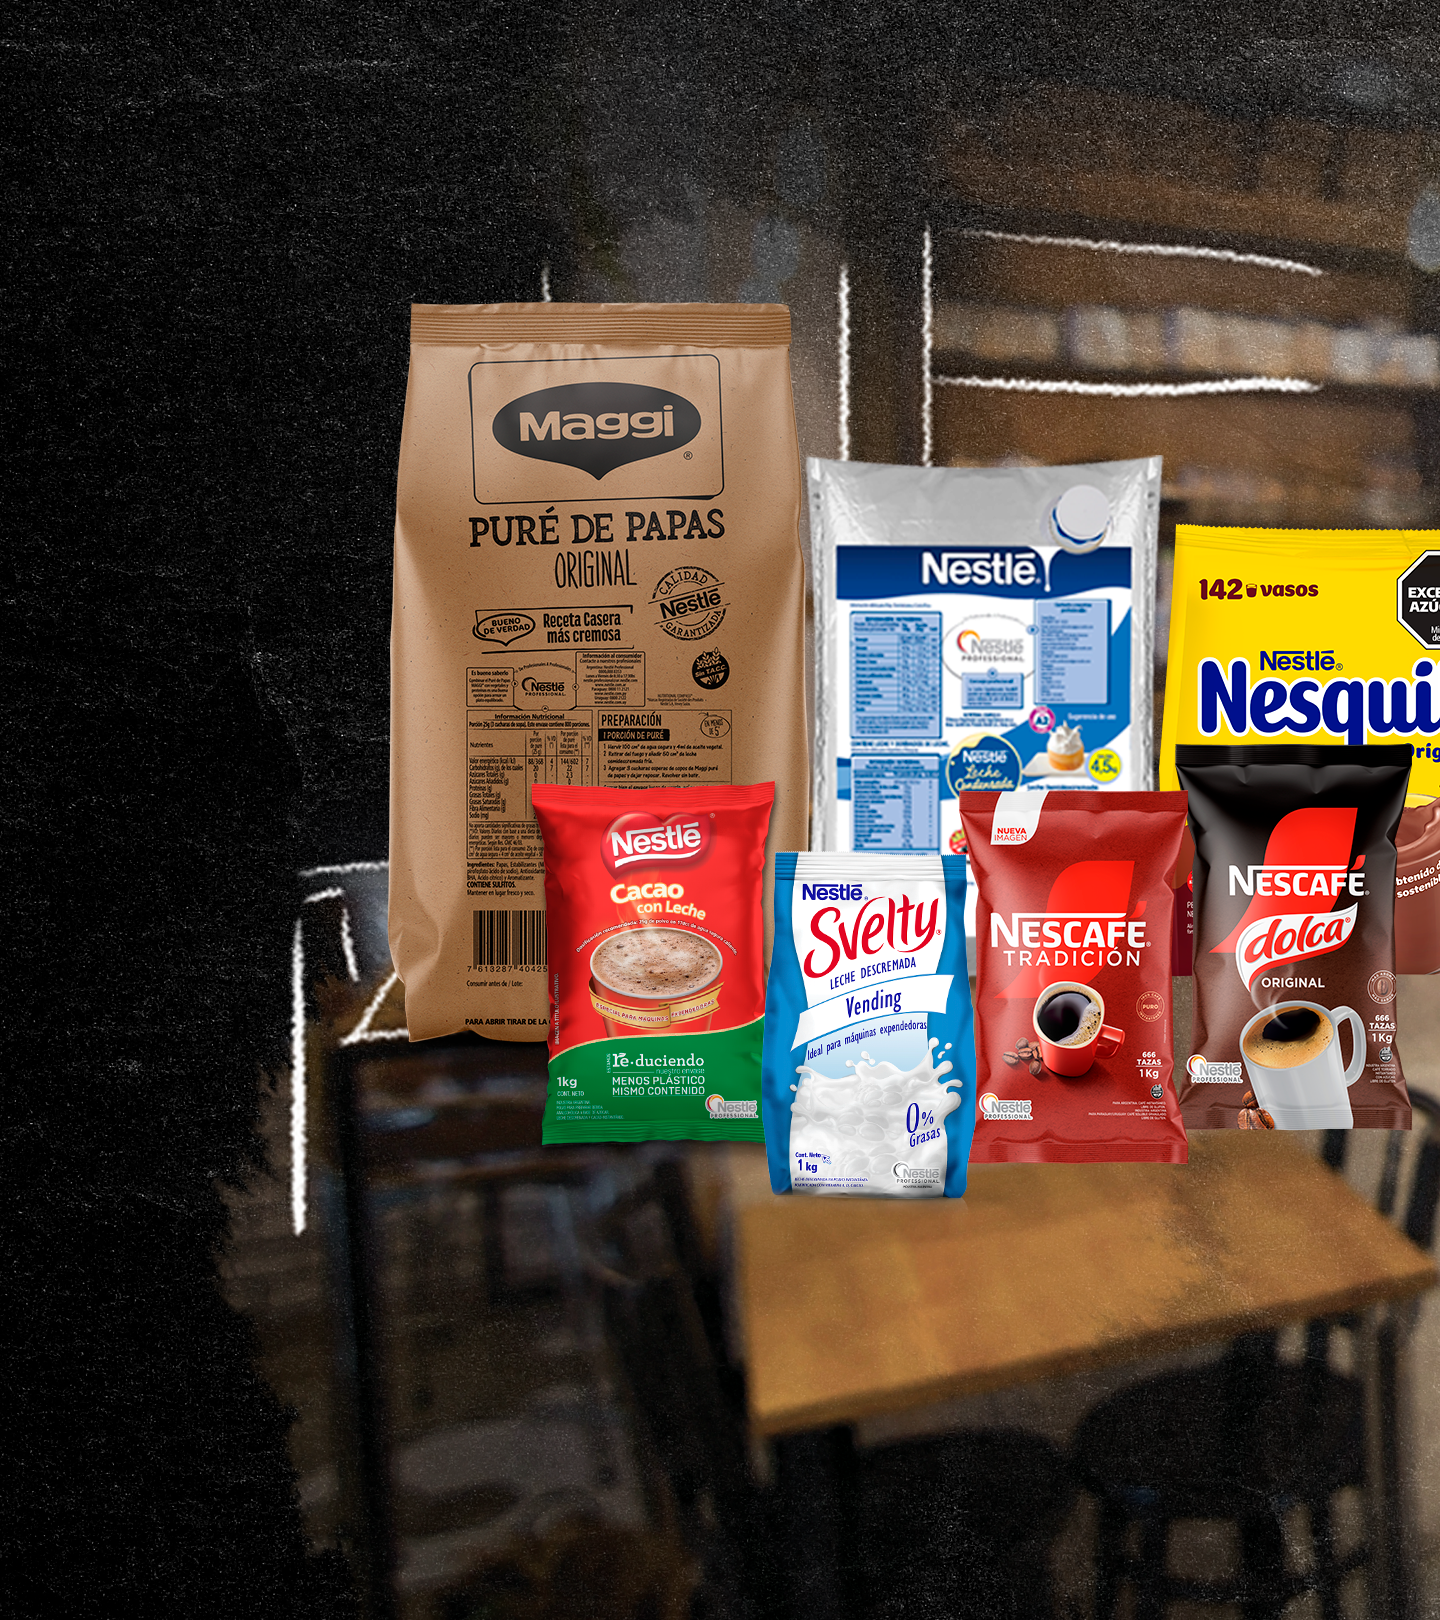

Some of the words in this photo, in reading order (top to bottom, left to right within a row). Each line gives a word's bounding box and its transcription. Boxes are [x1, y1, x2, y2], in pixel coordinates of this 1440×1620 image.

[519, 404, 674, 442] Maggi
[469, 506, 560, 548] PURÉ
[571, 513, 614, 544] DE
[625, 508, 726, 542] PAPAS
[554, 549, 637, 589] ORIGINAL
[922, 552, 1036, 585] Nestlé
[659, 571, 708, 595] CALIDAD
[1199, 578, 1244, 600] 142
[1260, 582, 1319, 598] vasos
[660, 588, 721, 619] Nestlé
[483, 627, 495, 635] DE
[496, 623, 530, 634] VERDAD
[491, 617, 521, 627] BUENO
[543, 612, 581, 628] Receta
[583, 612, 621, 627] Casera
[665, 610, 721, 637] GARANTIZADA
[547, 628, 570, 643] más
[572, 628, 621, 643] cremosa
[971, 638, 1024, 654] Nestlé
[1260, 650, 1335, 671] Nestlé
[531, 681, 565, 692] Nestlé
[602, 711, 662, 726] PREPARACIÓN
[607, 730, 635, 740] PORCIÓN
[636, 731, 646, 740] DE
[646, 730, 664, 740] PURÉ
[611, 820, 702, 857] Nestlé
[1229, 854, 1365, 897] NESCAFÉ
[1396, 866, 1435, 886] btenido
[610, 882, 684, 904] Cacao
[802, 884, 862, 901] Nestlé
[636, 902, 662, 914] con
[665, 900, 706, 920] Leche
[990, 901, 1147, 948] NESCAFÉ
[803, 894, 940, 979] Svelty
[1244, 915, 1343, 964] dolca
[1003, 946, 1140, 967] TRADICIÓN
[830, 971, 856, 990] LECHE
[860, 956, 916, 979] DESCREMADA
[1261, 976, 1324, 989] ORIGINAL
[595, 1002, 621, 1017] ESPECIAL
[621, 1012, 637, 1021] PARA
[638, 1014, 669, 1023] MÁQUINAS
[846, 990, 902, 1018] Vending
[807, 1044, 823, 1062] Ideal
[826, 1039, 842, 1056] para
[844, 1028, 877, 1047] máquinas
[879, 1020, 928, 1040] expendedoras
[1378, 1033, 1392, 1043] Kg
[1145, 1069, 1159, 1079] Kg
[1198, 1061, 1241, 1075] Nestlé
[556, 1077, 577, 1088] 1kg
[612, 1076, 650, 1085] MENOS
[652, 1074, 705, 1085] PLÁSTICO
[612, 1087, 645, 1095] MISMO
[648, 1087, 705, 1095] CONTENIDO
[717, 1101, 757, 1113] Nestlé
[991, 1100, 1031, 1113] Nestlé
[909, 1128, 941, 1148] Grasas
[798, 1159, 802, 1171] 1
[806, 1162, 818, 1173] kg
[903, 1169, 940, 1178] Nestlé
